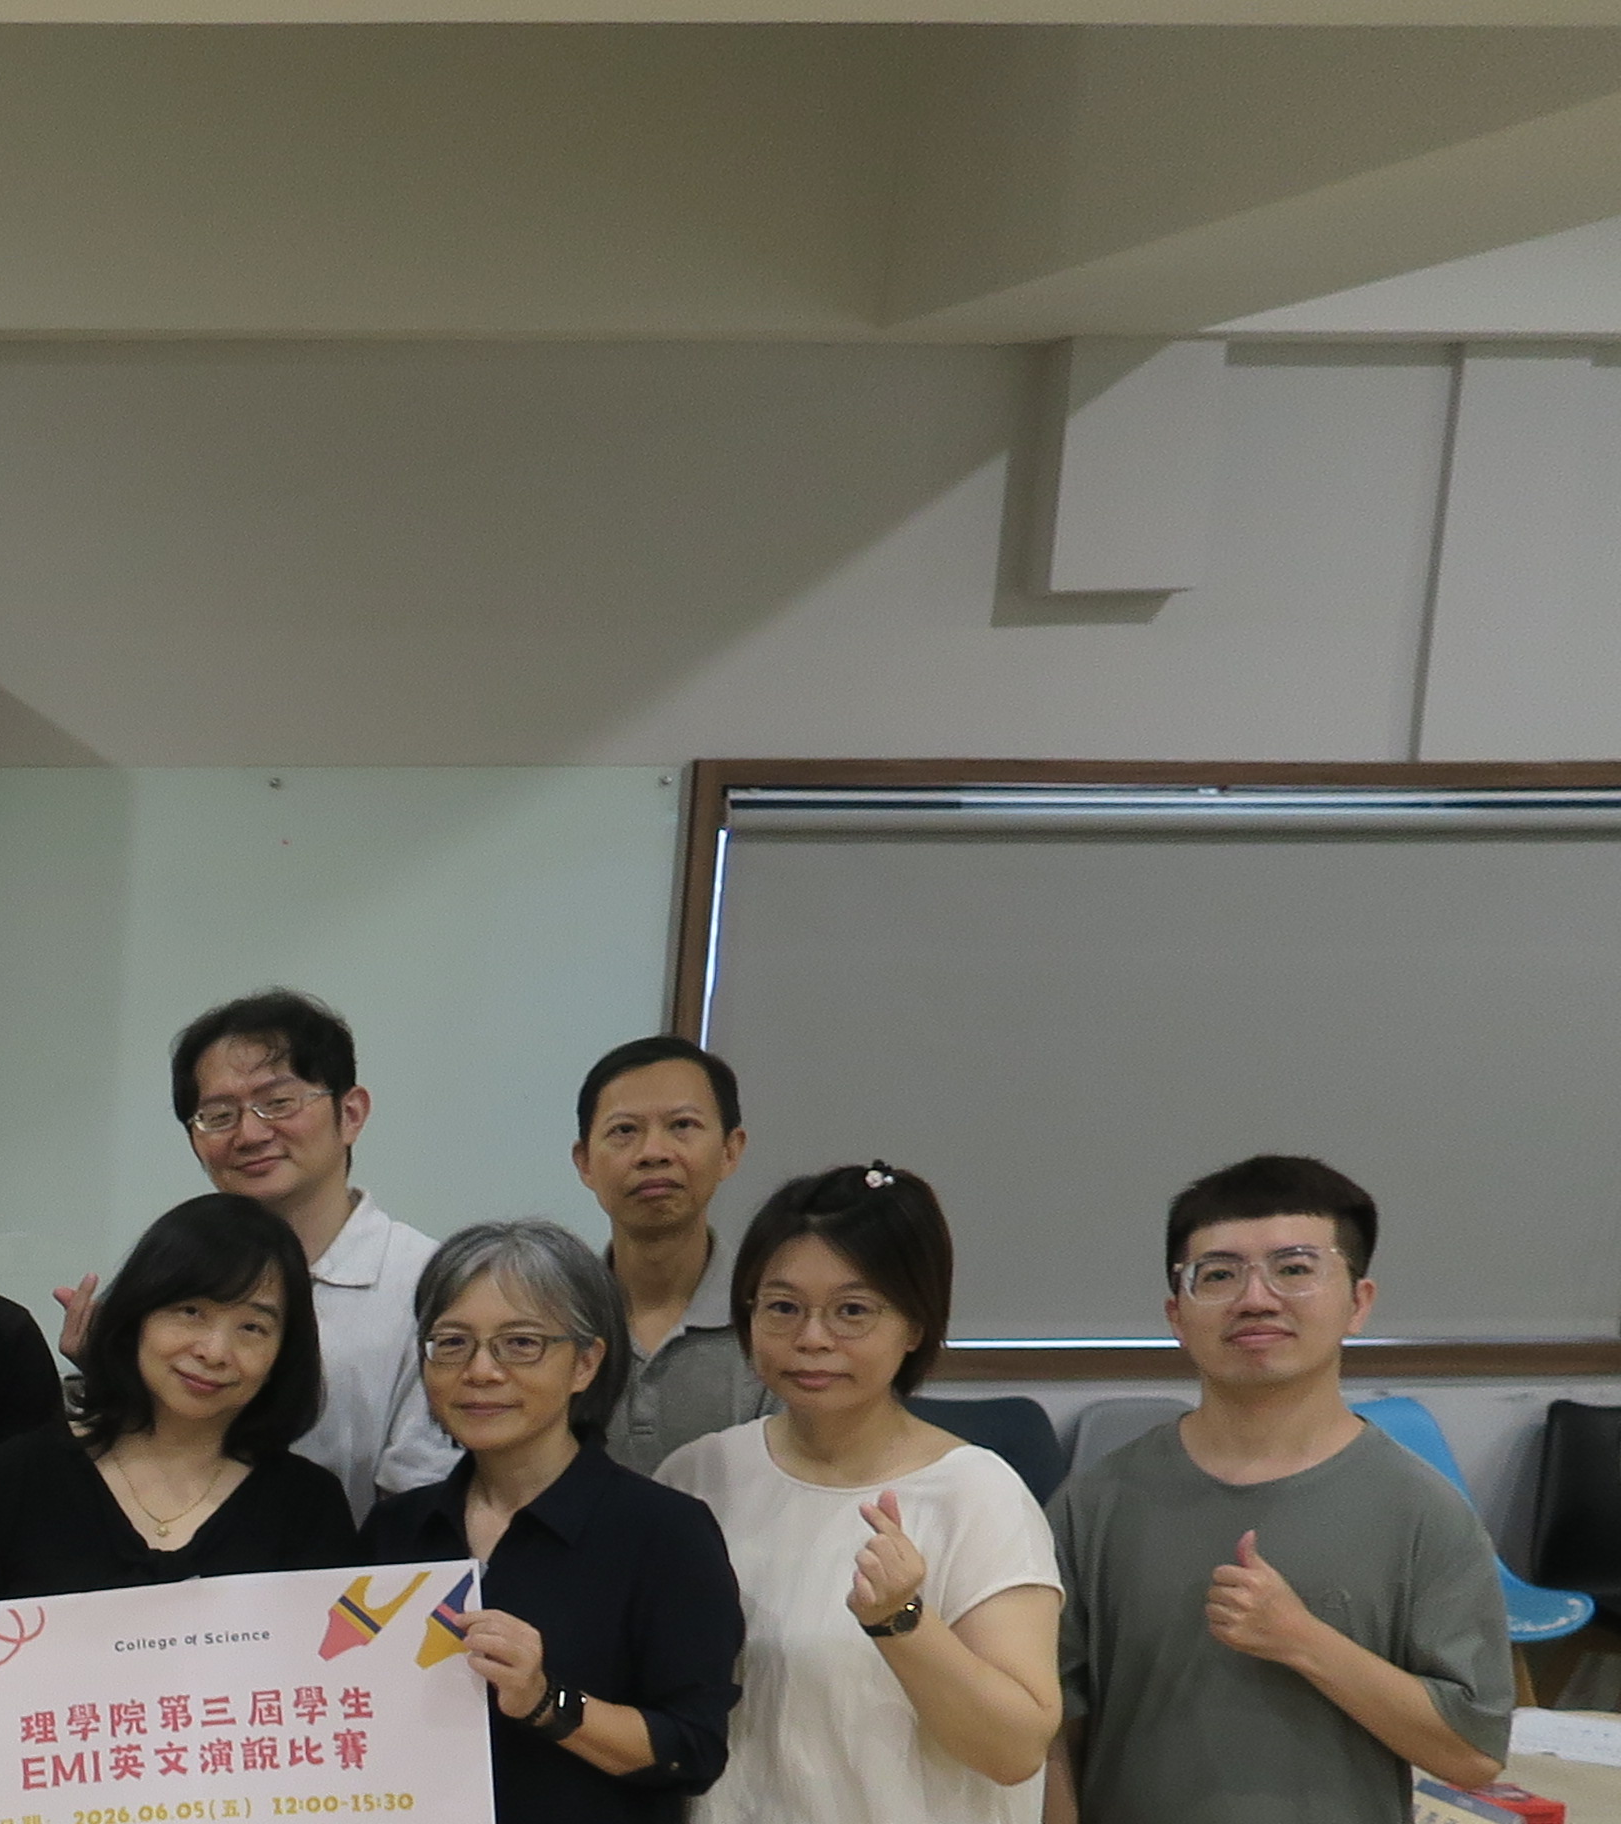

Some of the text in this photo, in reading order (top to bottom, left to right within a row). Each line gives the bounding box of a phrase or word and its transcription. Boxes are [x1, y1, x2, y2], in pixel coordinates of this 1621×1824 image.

[114, 1628, 272, 1653] College of Science
[20, 1685, 374, 1746] 理學院第三屆學生
[21, 1728, 369, 1791] EMI英文演說比賽
[271, 1791, 416, 1817] 12:00-15:30
